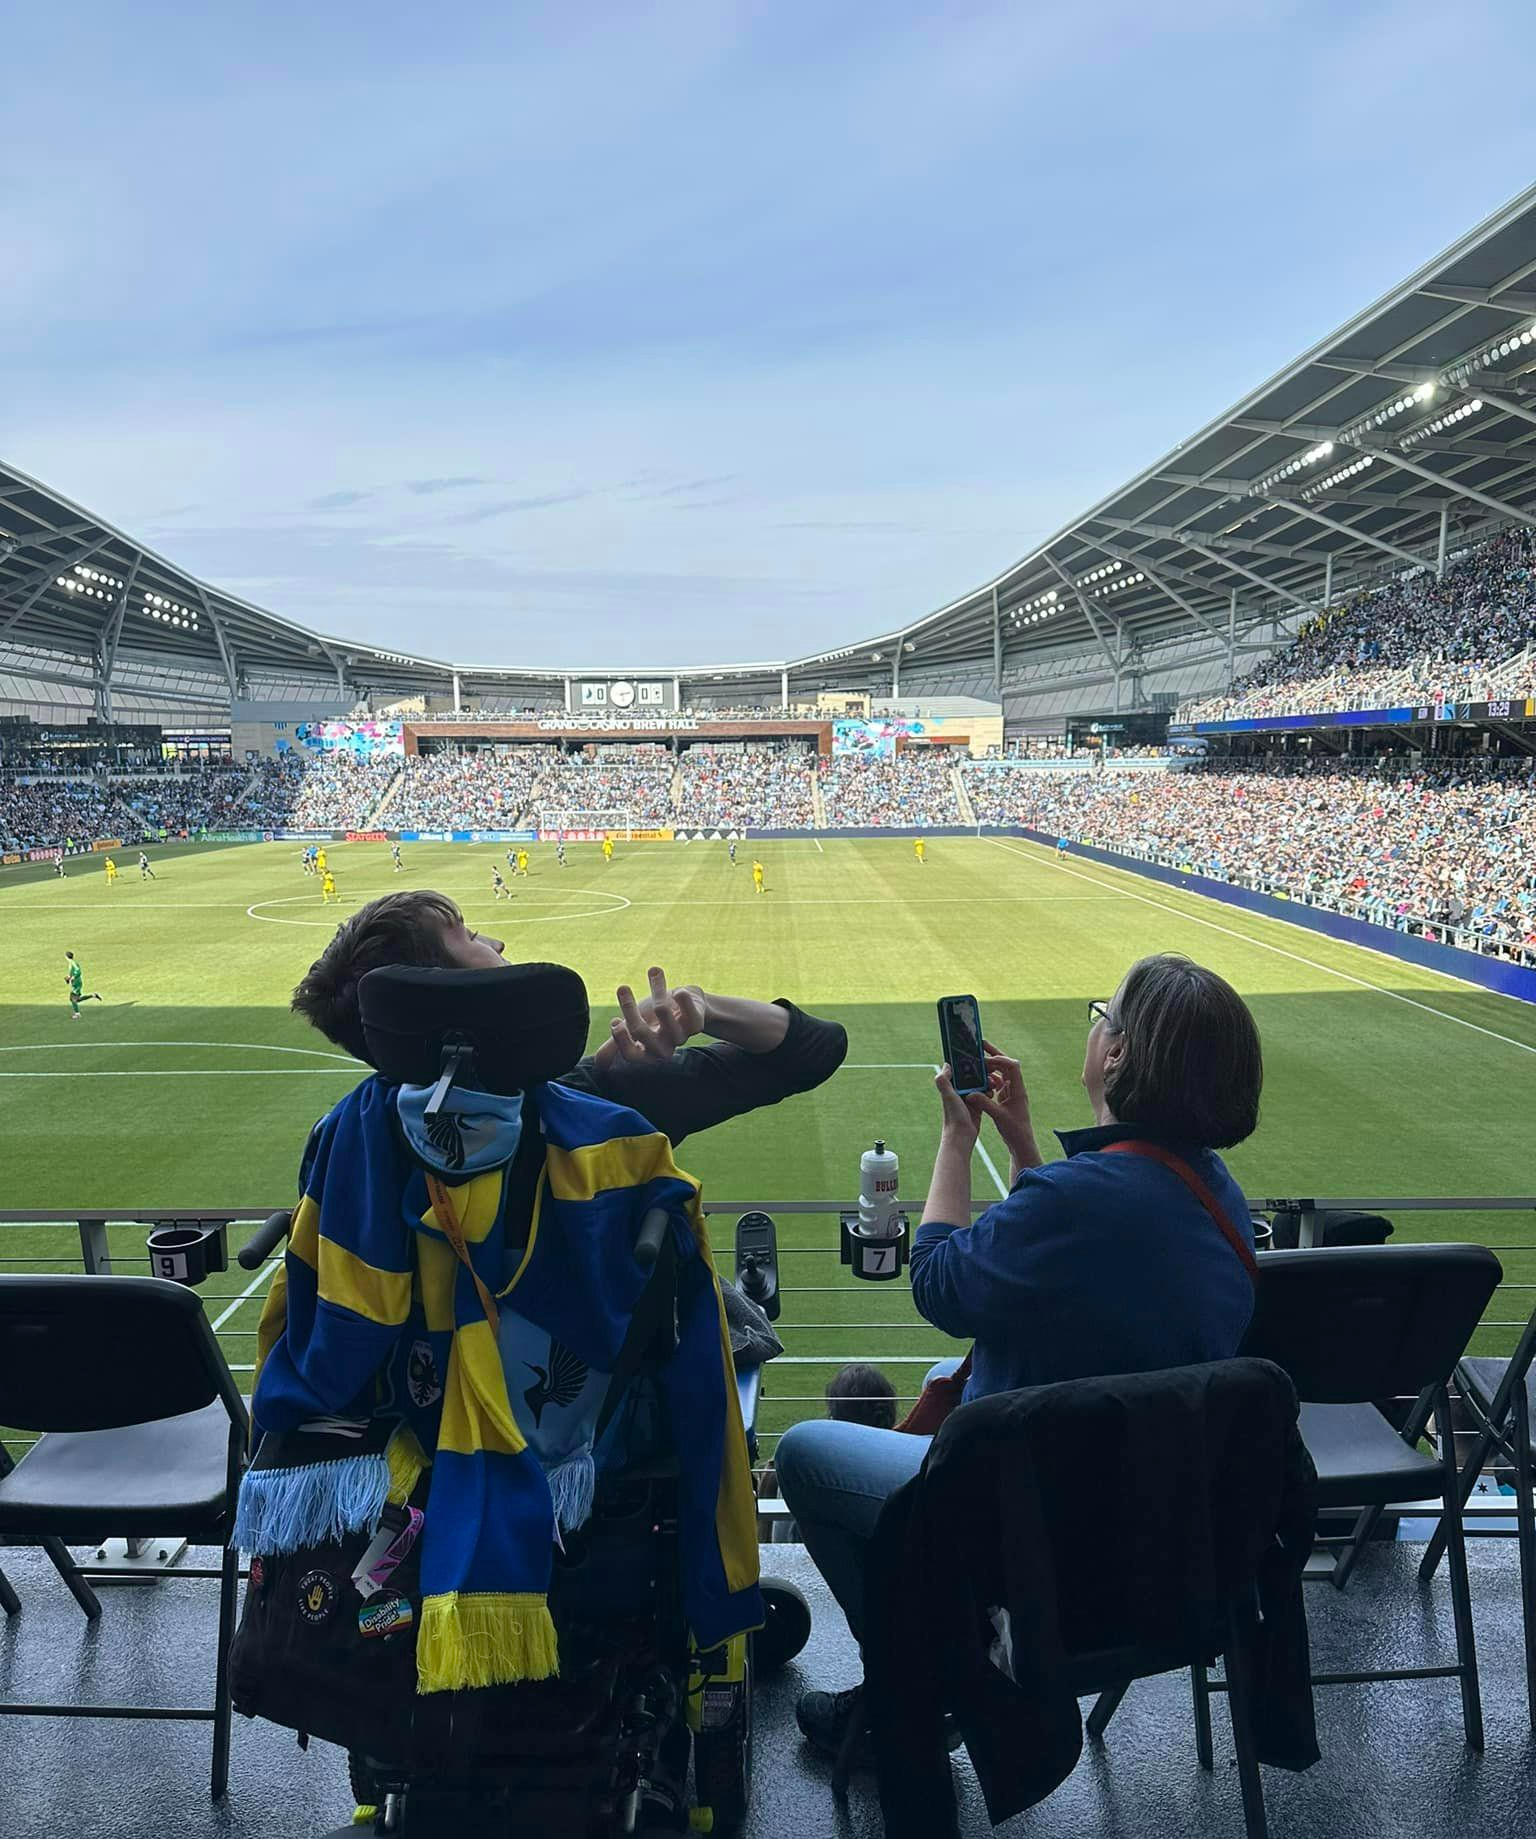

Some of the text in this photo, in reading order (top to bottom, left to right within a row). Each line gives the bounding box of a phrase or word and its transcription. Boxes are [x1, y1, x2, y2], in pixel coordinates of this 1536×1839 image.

[1488, 701, 1510, 717] 13:29
[537, 719, 699, 731] GRAND CASINO BREW HALL
[161, 1257, 175, 1277] 9
[873, 1251, 886, 1271] 7
[364, 1598, 400, 1629] Disability
[375, 1611, 399, 1632] Pride!
